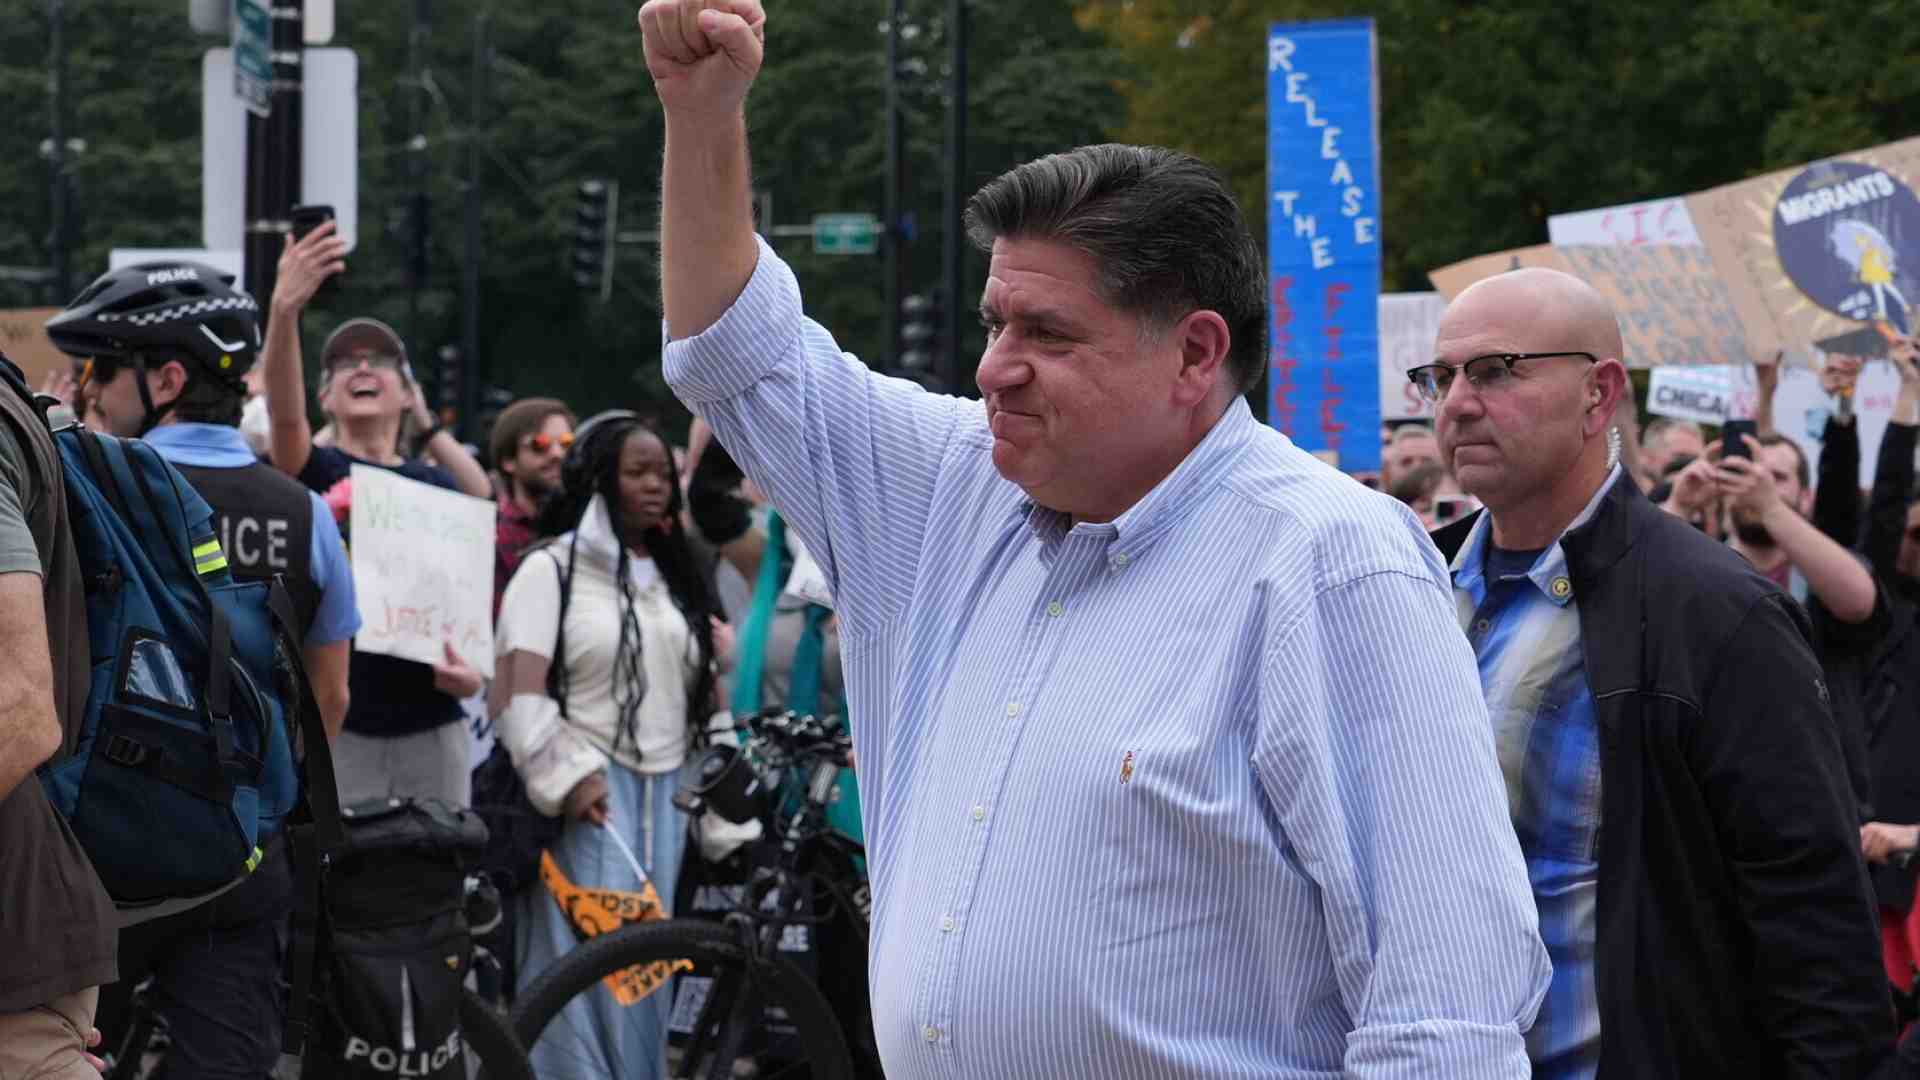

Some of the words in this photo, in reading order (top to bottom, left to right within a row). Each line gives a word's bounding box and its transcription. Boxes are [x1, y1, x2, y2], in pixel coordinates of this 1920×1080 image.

[1268, 35, 1375, 245] RELEASE
[1778, 171, 1896, 225] MIGRANTS
[1274, 190, 1334, 270] THE
[147, 268, 198, 286] POLICE
[1656, 383, 1725, 416] CHICA
[221, 514, 289, 569] ICE
[344, 1029, 460, 1077] POLICE
